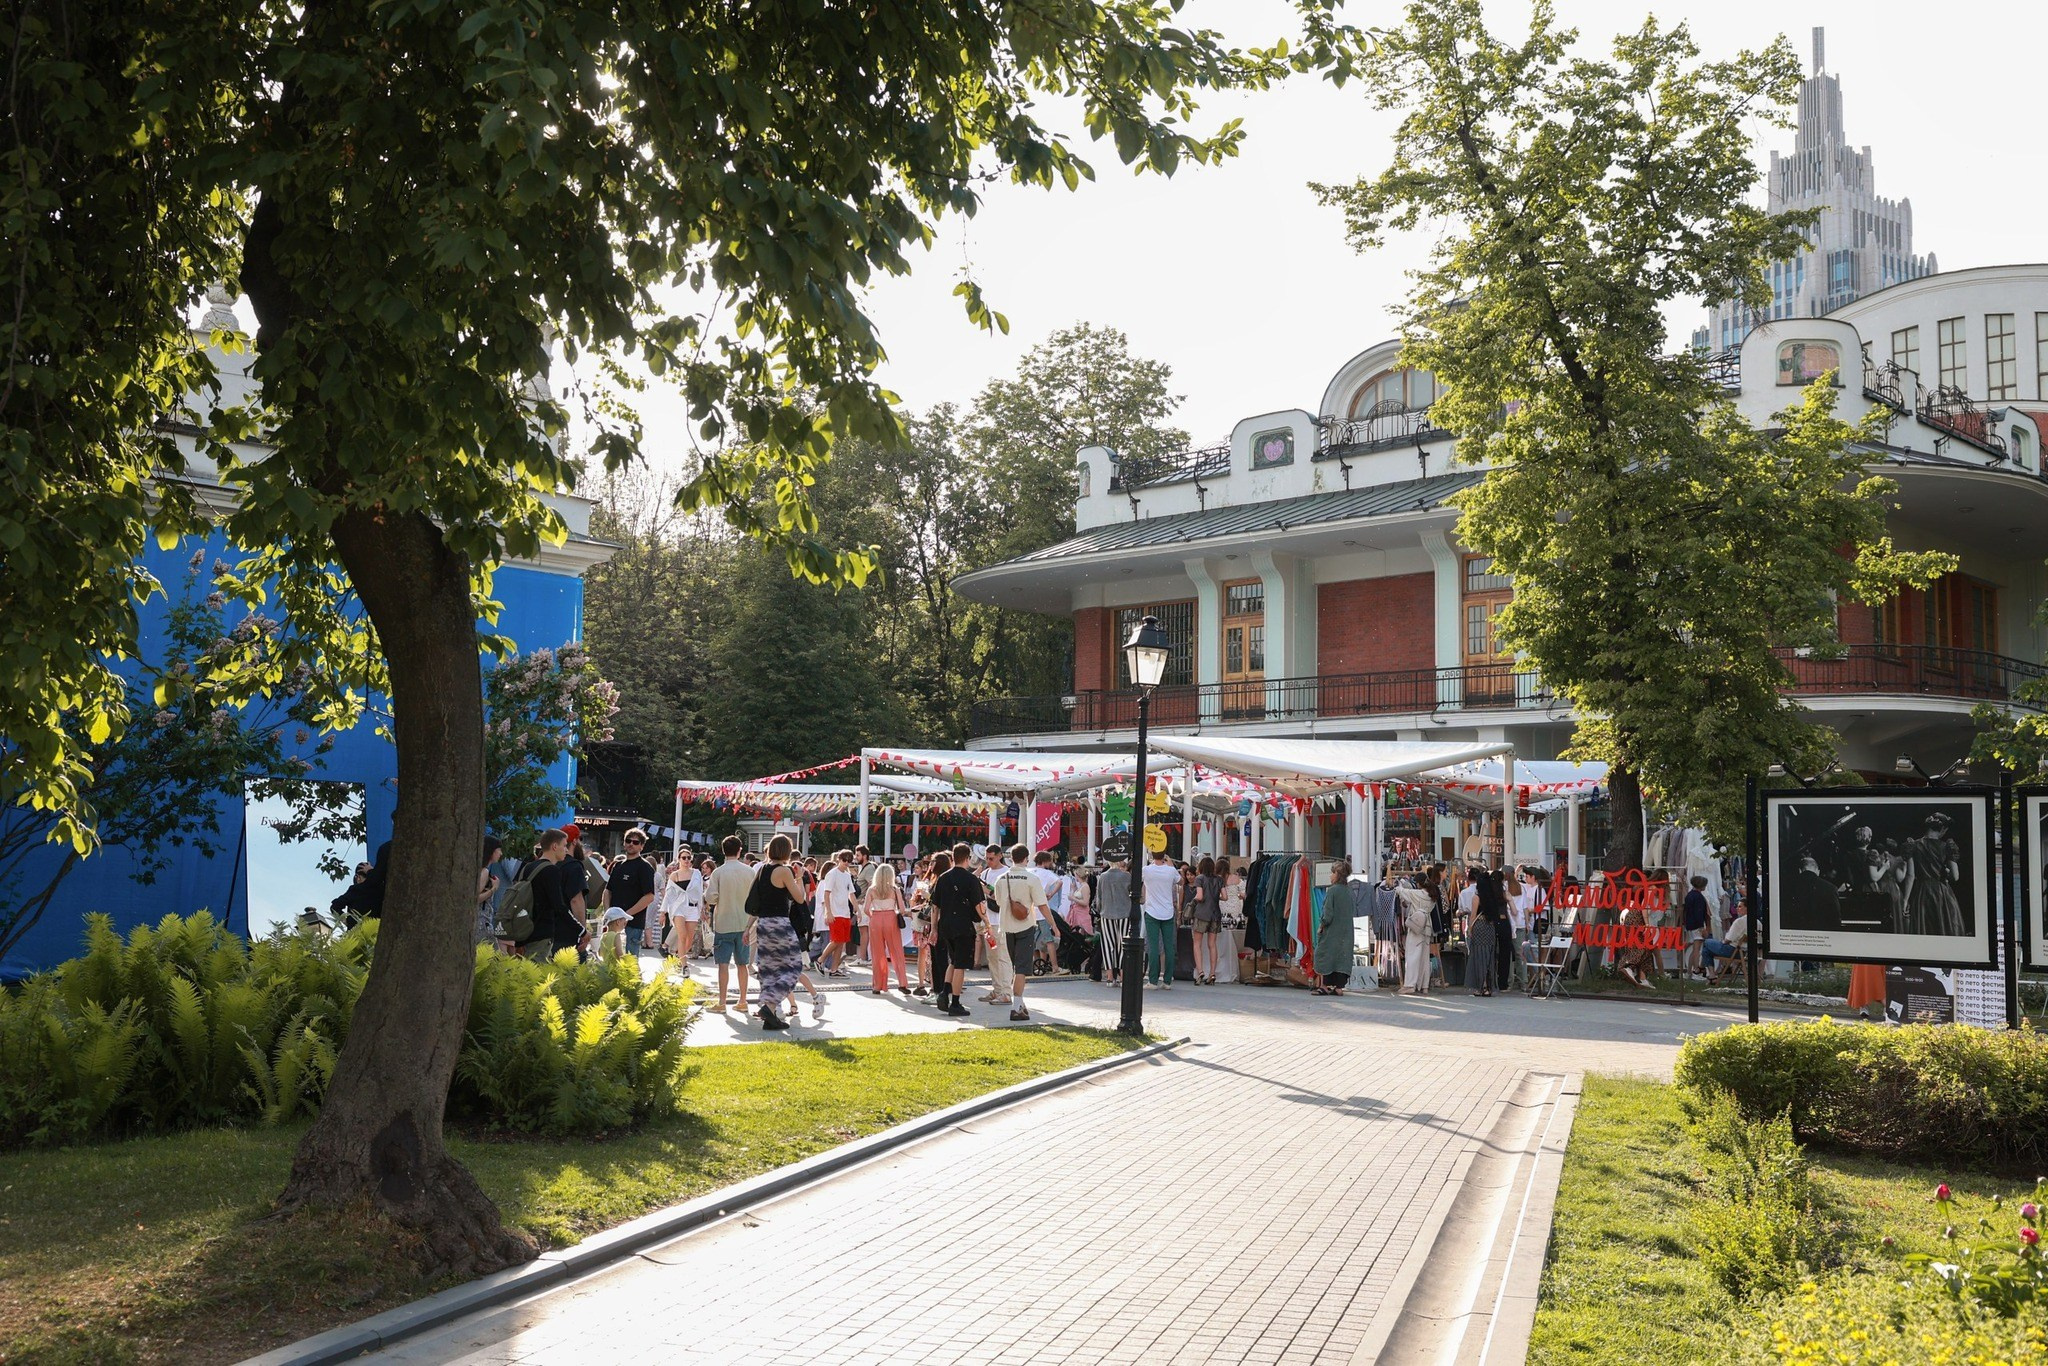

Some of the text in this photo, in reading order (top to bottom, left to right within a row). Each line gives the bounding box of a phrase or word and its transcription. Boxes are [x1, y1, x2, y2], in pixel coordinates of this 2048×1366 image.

[1035, 812, 1060, 844] aspire
[1534, 866, 1669, 912] Ламбада
[1573, 922, 1687, 962] маркет
